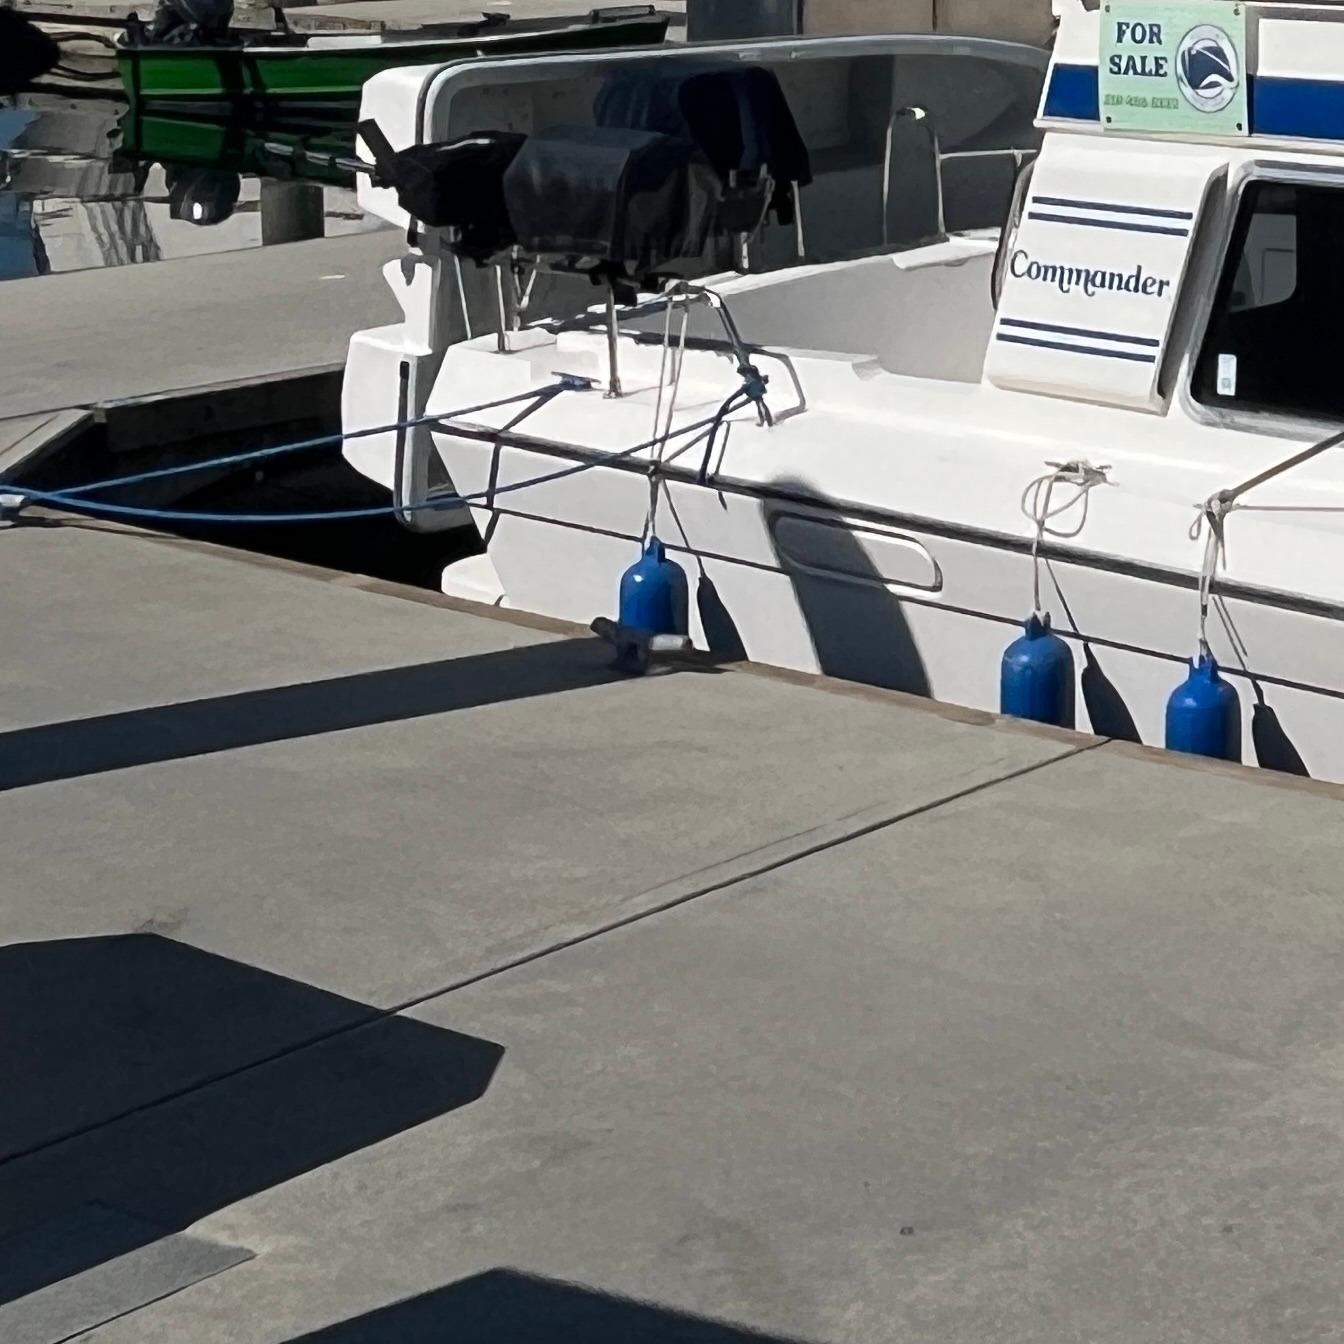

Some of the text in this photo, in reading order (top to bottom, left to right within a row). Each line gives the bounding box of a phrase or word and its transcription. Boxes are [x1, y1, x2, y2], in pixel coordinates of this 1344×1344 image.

[1115, 21, 1163, 46] FOR
[1108, 54, 1169, 78] SALE
[1009, 249, 1171, 298] Commander
